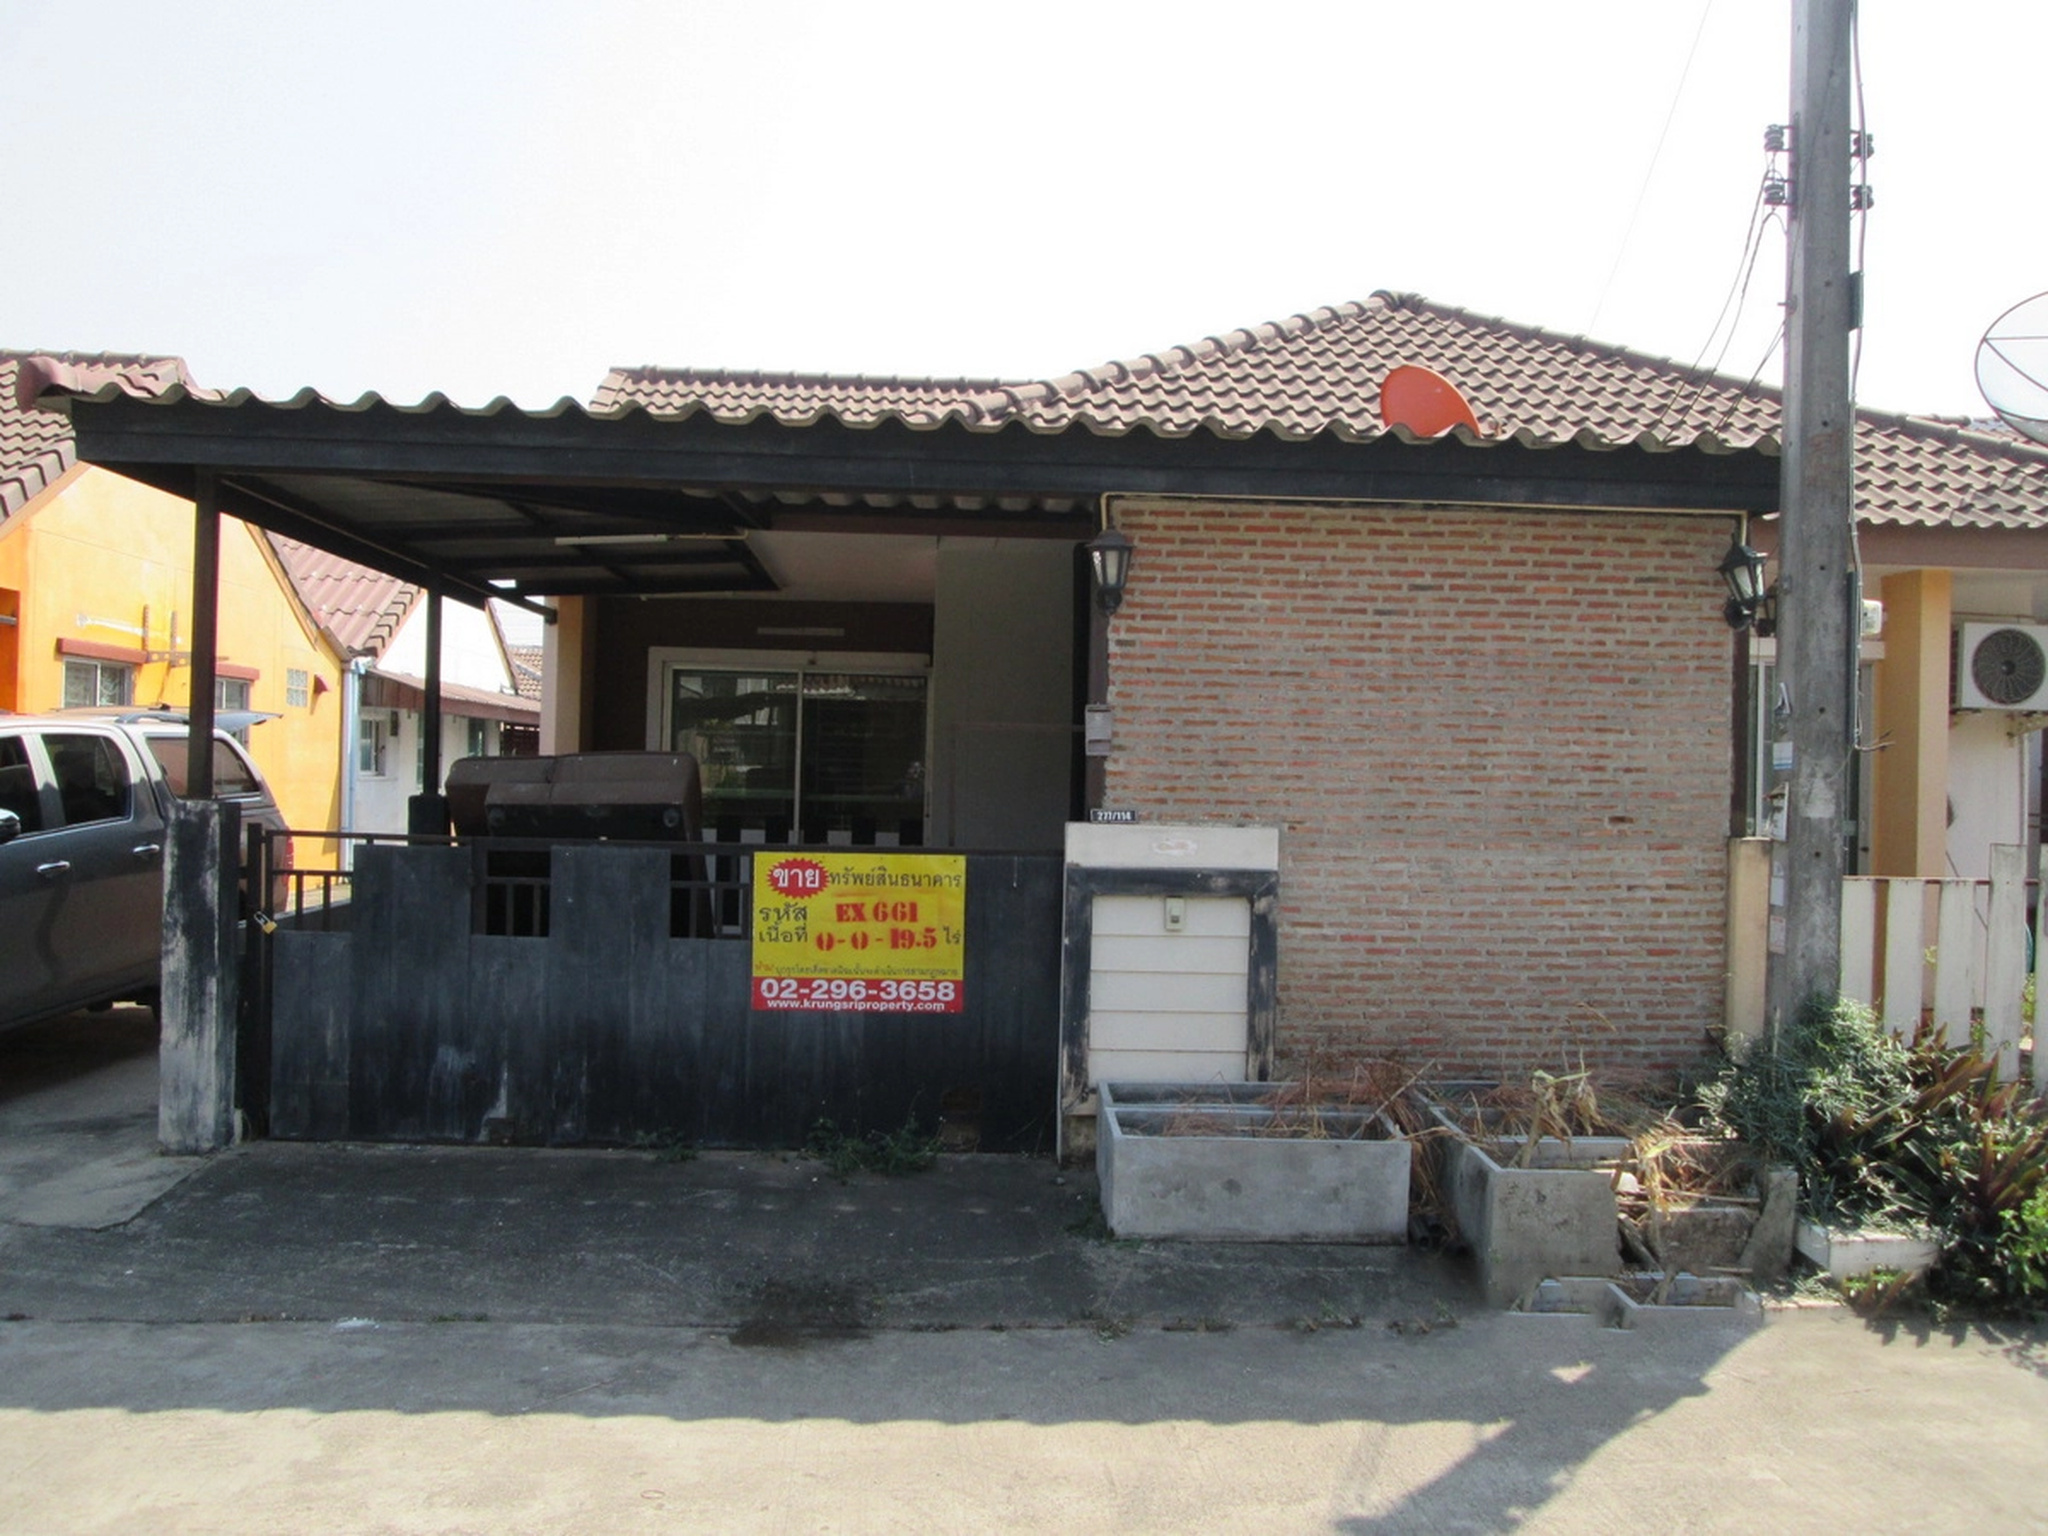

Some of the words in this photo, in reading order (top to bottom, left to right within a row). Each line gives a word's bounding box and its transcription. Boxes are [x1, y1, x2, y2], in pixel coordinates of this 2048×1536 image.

[773, 867, 820, 888] ขาย
[829, 866, 963, 888] ทรัพย์สินธนาคาร
[759, 902, 808, 922] รหัส
[836, 903, 868, 923] EX
[873, 901, 918, 923] 661
[759, 920, 808, 943] เนื้อที่
[944, 925, 960, 945] ไร่
[760, 978, 955, 1001] 02-296-3658
[767, 998, 945, 1012] www.krungsriproperty.com
